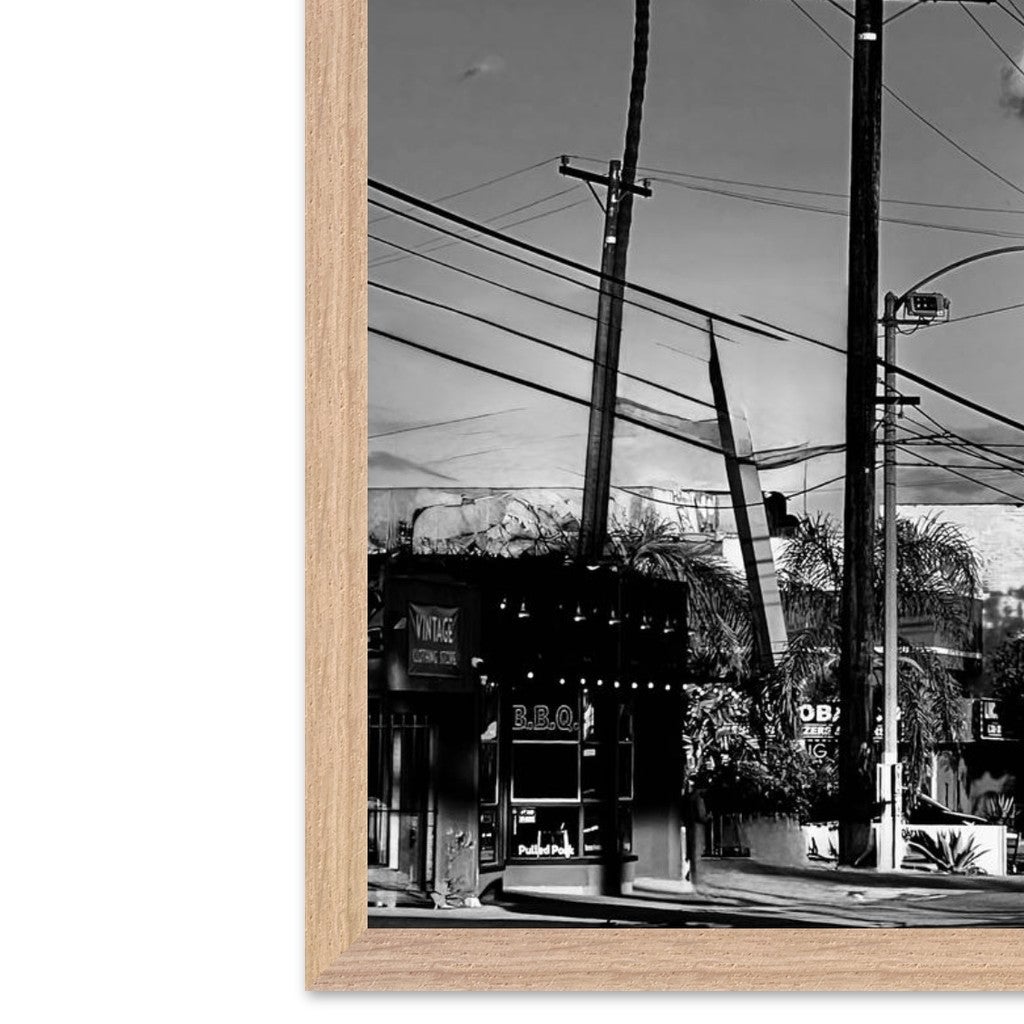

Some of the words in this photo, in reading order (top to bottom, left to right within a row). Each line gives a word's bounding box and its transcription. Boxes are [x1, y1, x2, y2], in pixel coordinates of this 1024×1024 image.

[415, 614, 454, 643] VINTAGE
[512, 704, 580, 731] B.B.Q.
[551, 844, 576, 856] Pok
